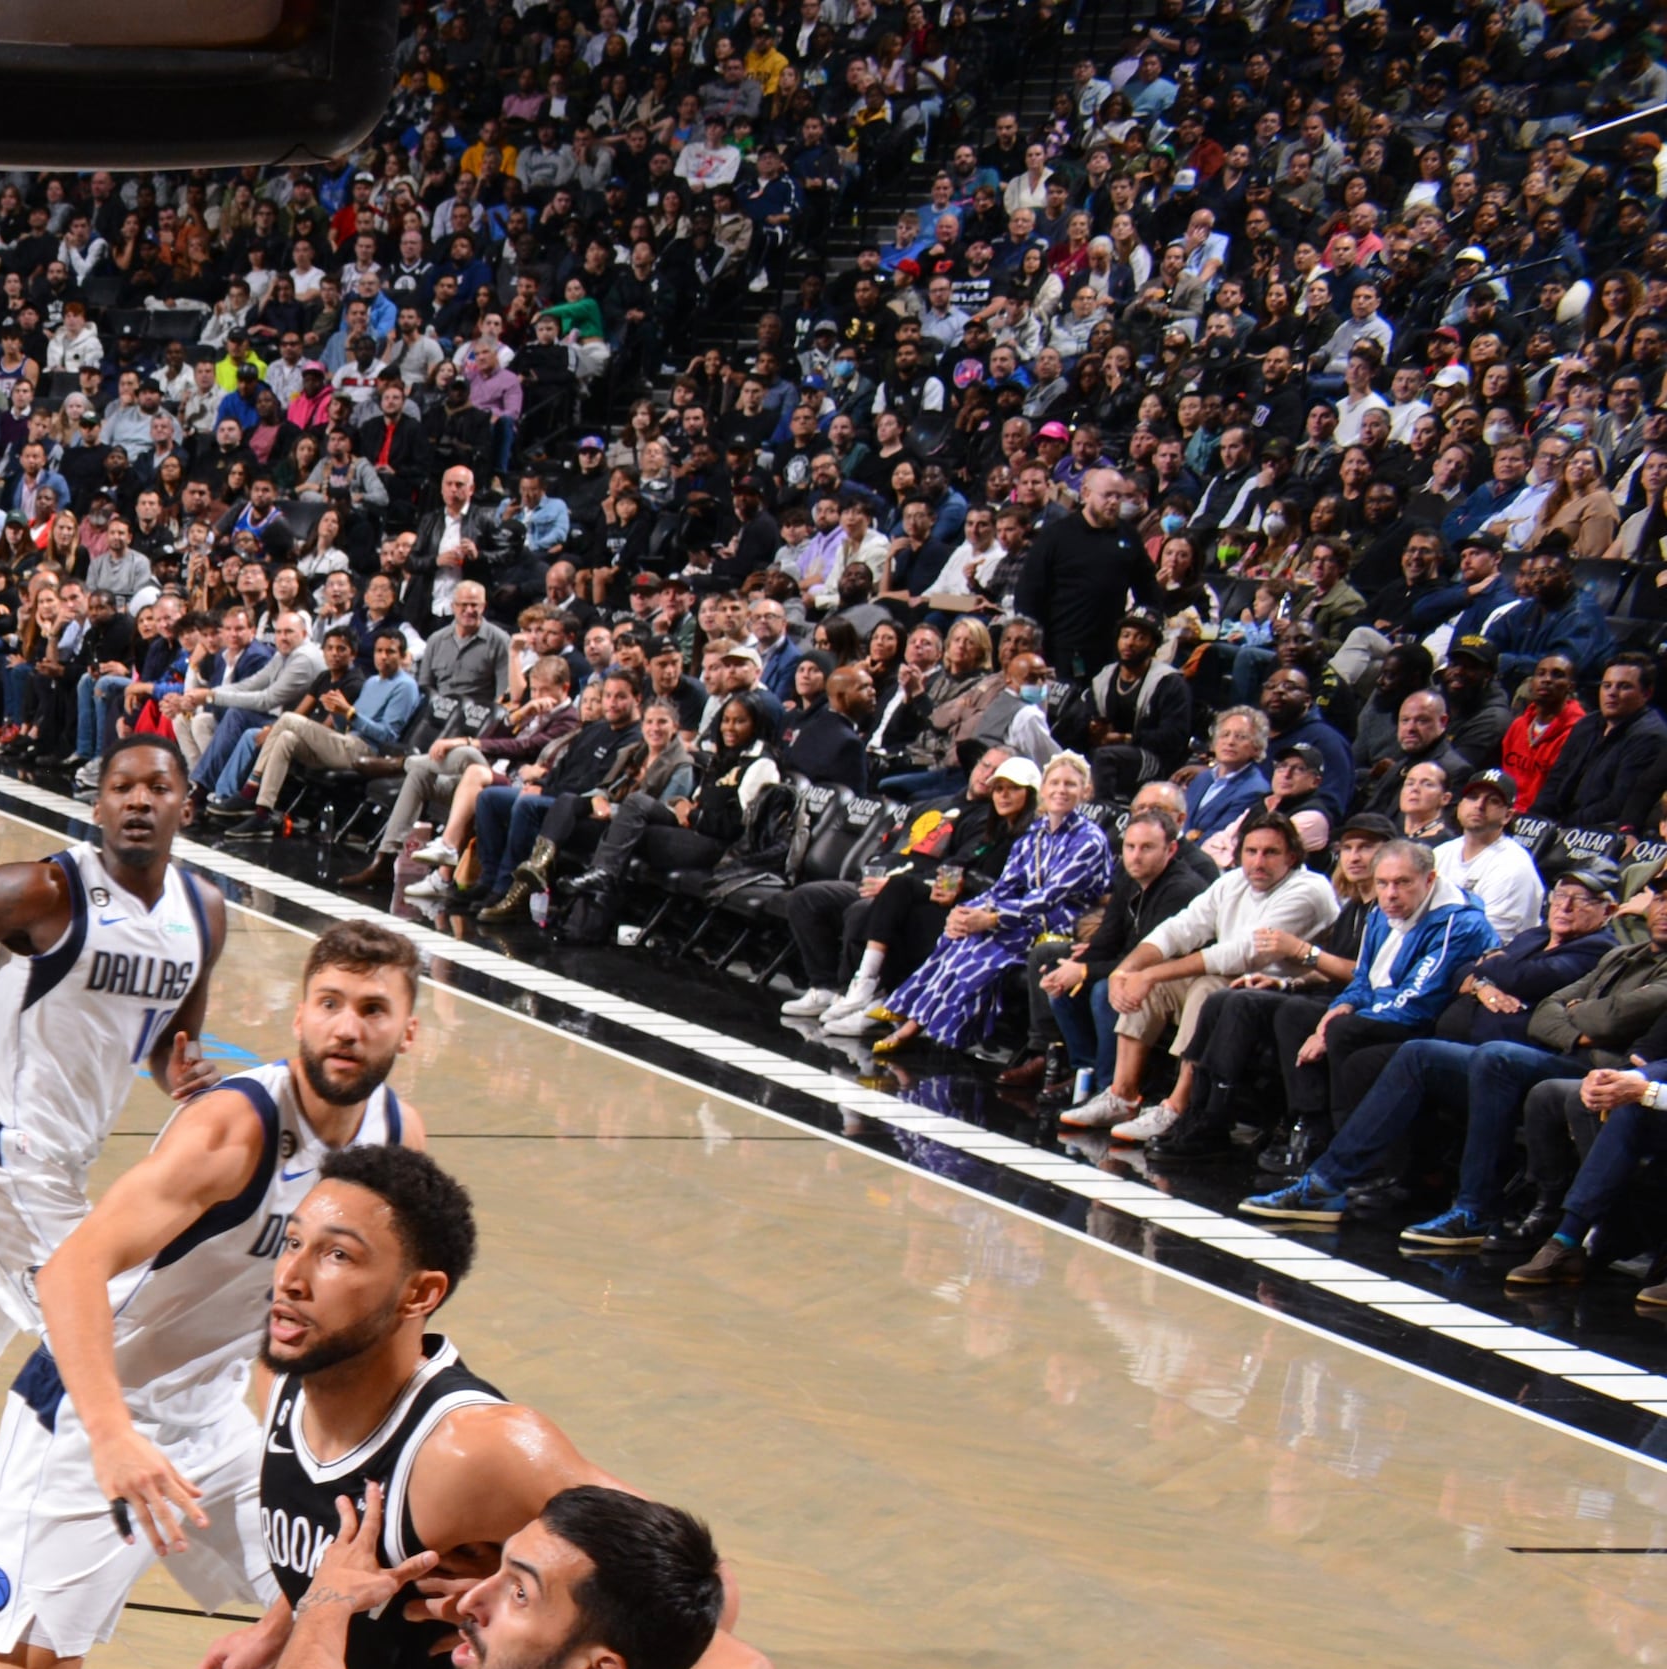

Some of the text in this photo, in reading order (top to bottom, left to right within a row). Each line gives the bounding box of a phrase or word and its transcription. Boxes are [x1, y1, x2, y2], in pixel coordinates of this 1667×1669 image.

[1564, 828, 1613, 852] QATAR
[86, 951, 193, 1000] DALLAS
[277, 1399, 291, 1427] 6
